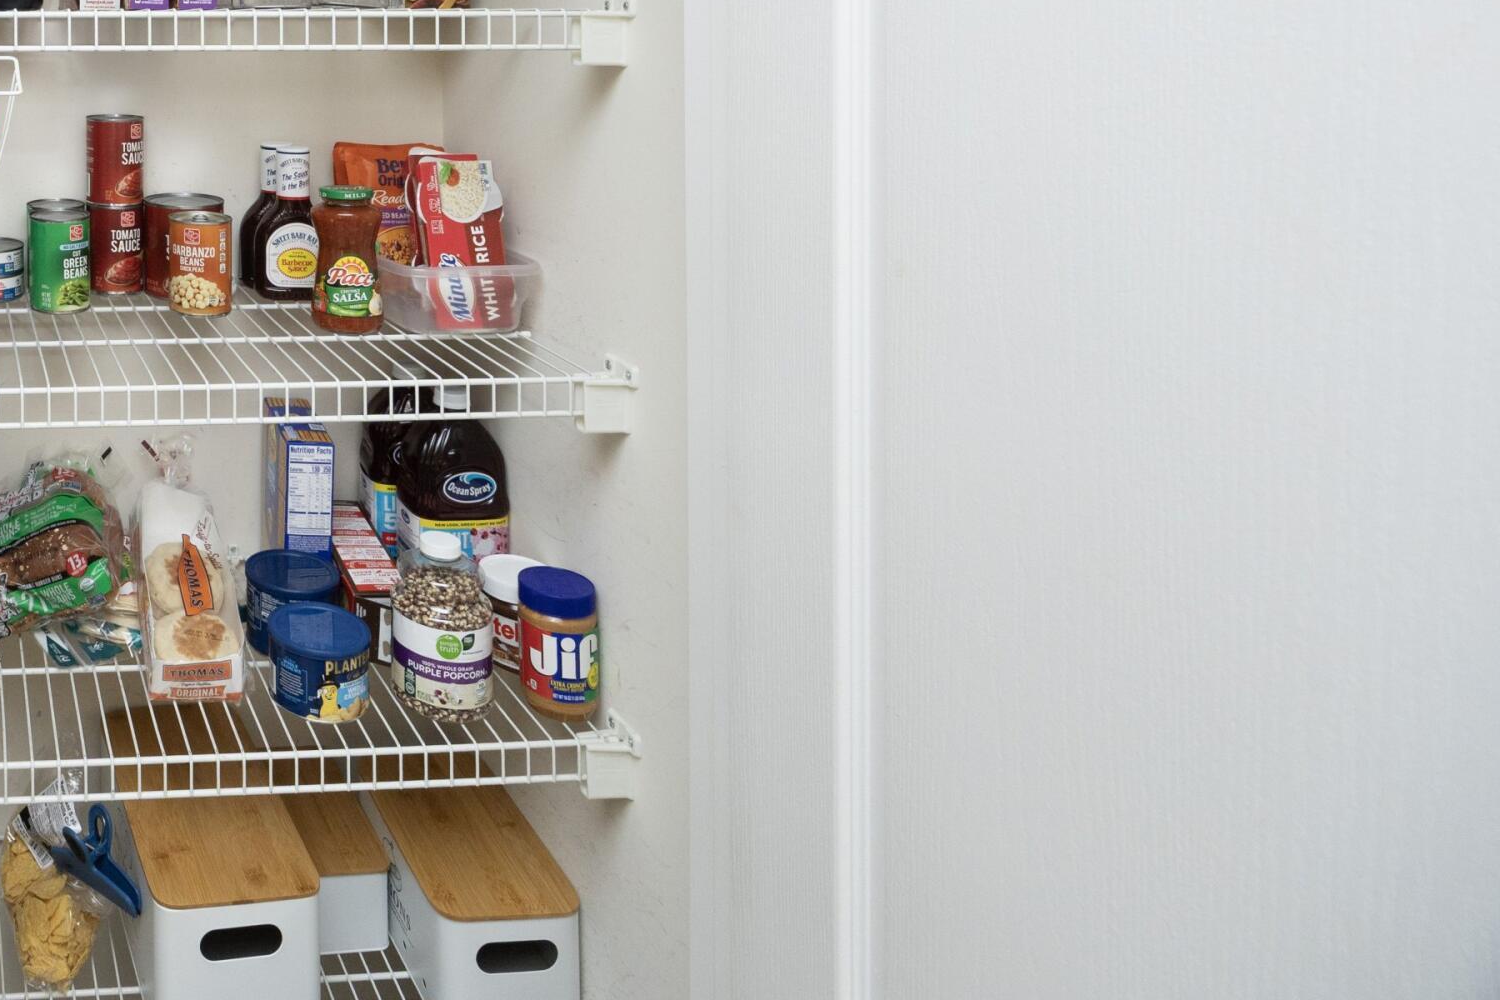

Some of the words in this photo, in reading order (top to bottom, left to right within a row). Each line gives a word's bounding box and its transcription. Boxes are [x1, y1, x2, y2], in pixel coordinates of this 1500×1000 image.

[282, 173, 292, 181] The
[281, 183, 287, 191] is
[287, 181, 298, 190] the
[344, 192, 367, 200] MILD
[110, 228, 141, 240] TOMATO
[272, 233, 290, 247] SWEET
[290, 231, 306, 241] BABY
[110, 239, 141, 253] SAUCE
[173, 243, 215, 258] GARBANZO
[470, 225, 490, 264] RICE
[63, 256, 88, 269] GREEN
[180, 256, 205, 267] BEANS
[281, 258, 313, 267] Barbecue
[63, 266, 89, 280] BEANS
[332, 292, 368, 304] SALSA
[480, 273, 501, 321] WHIT
[290, 446, 315, 455] Nutrition
[316, 447, 332, 455] Facts
[447, 481, 470, 497] Ocean
[469, 482, 492, 498] Spray
[529, 633, 598, 680] Jif
[407, 658, 442, 678] PURPLE
[443, 668, 486, 680] POPCORN
[421, 660, 436, 668] 100%
[437, 664, 458, 672] WHOLE
[169, 667, 225, 678] THOMAS
[176, 687, 220, 698] ORIGINAL
